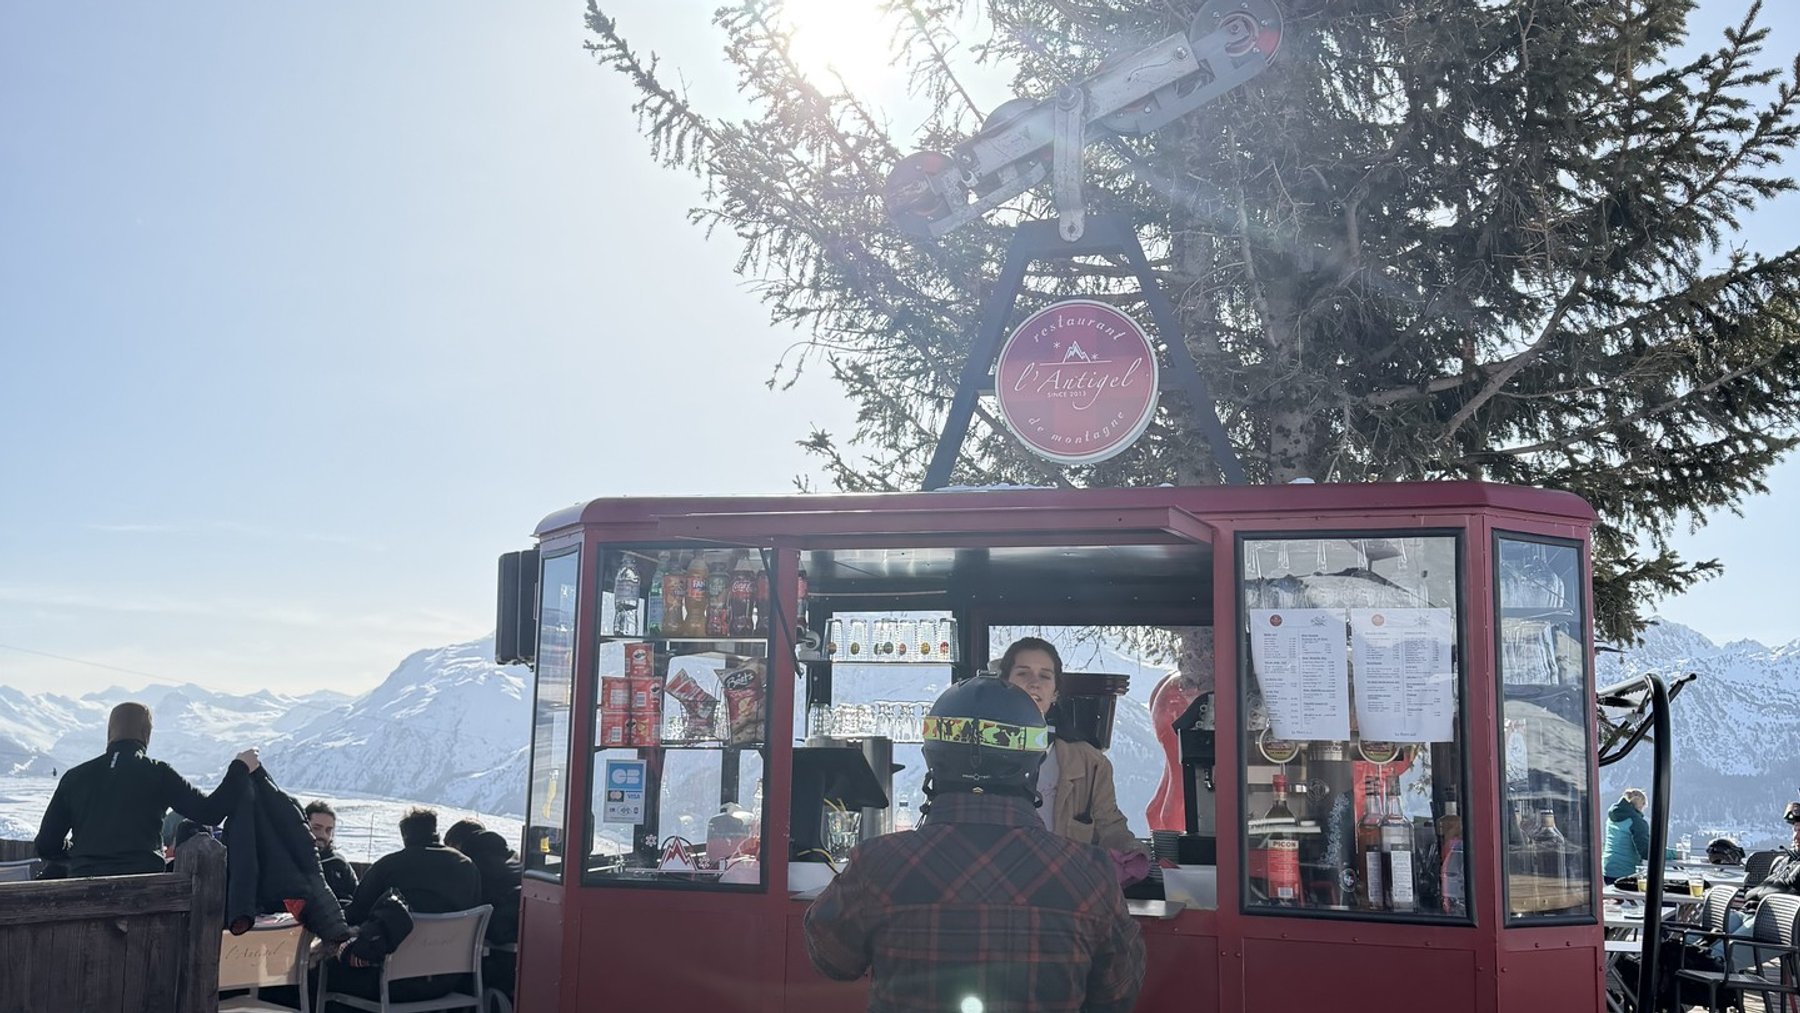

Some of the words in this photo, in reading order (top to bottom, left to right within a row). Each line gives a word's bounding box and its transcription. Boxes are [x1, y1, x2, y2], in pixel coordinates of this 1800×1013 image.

[1032, 314, 1127, 343] restaurant
[1014, 357, 1143, 411] l'Antigel
[1047, 391, 1067, 399] SINCE
[1028, 416, 1044, 433] de
[1050, 411, 1125, 445] montagne
